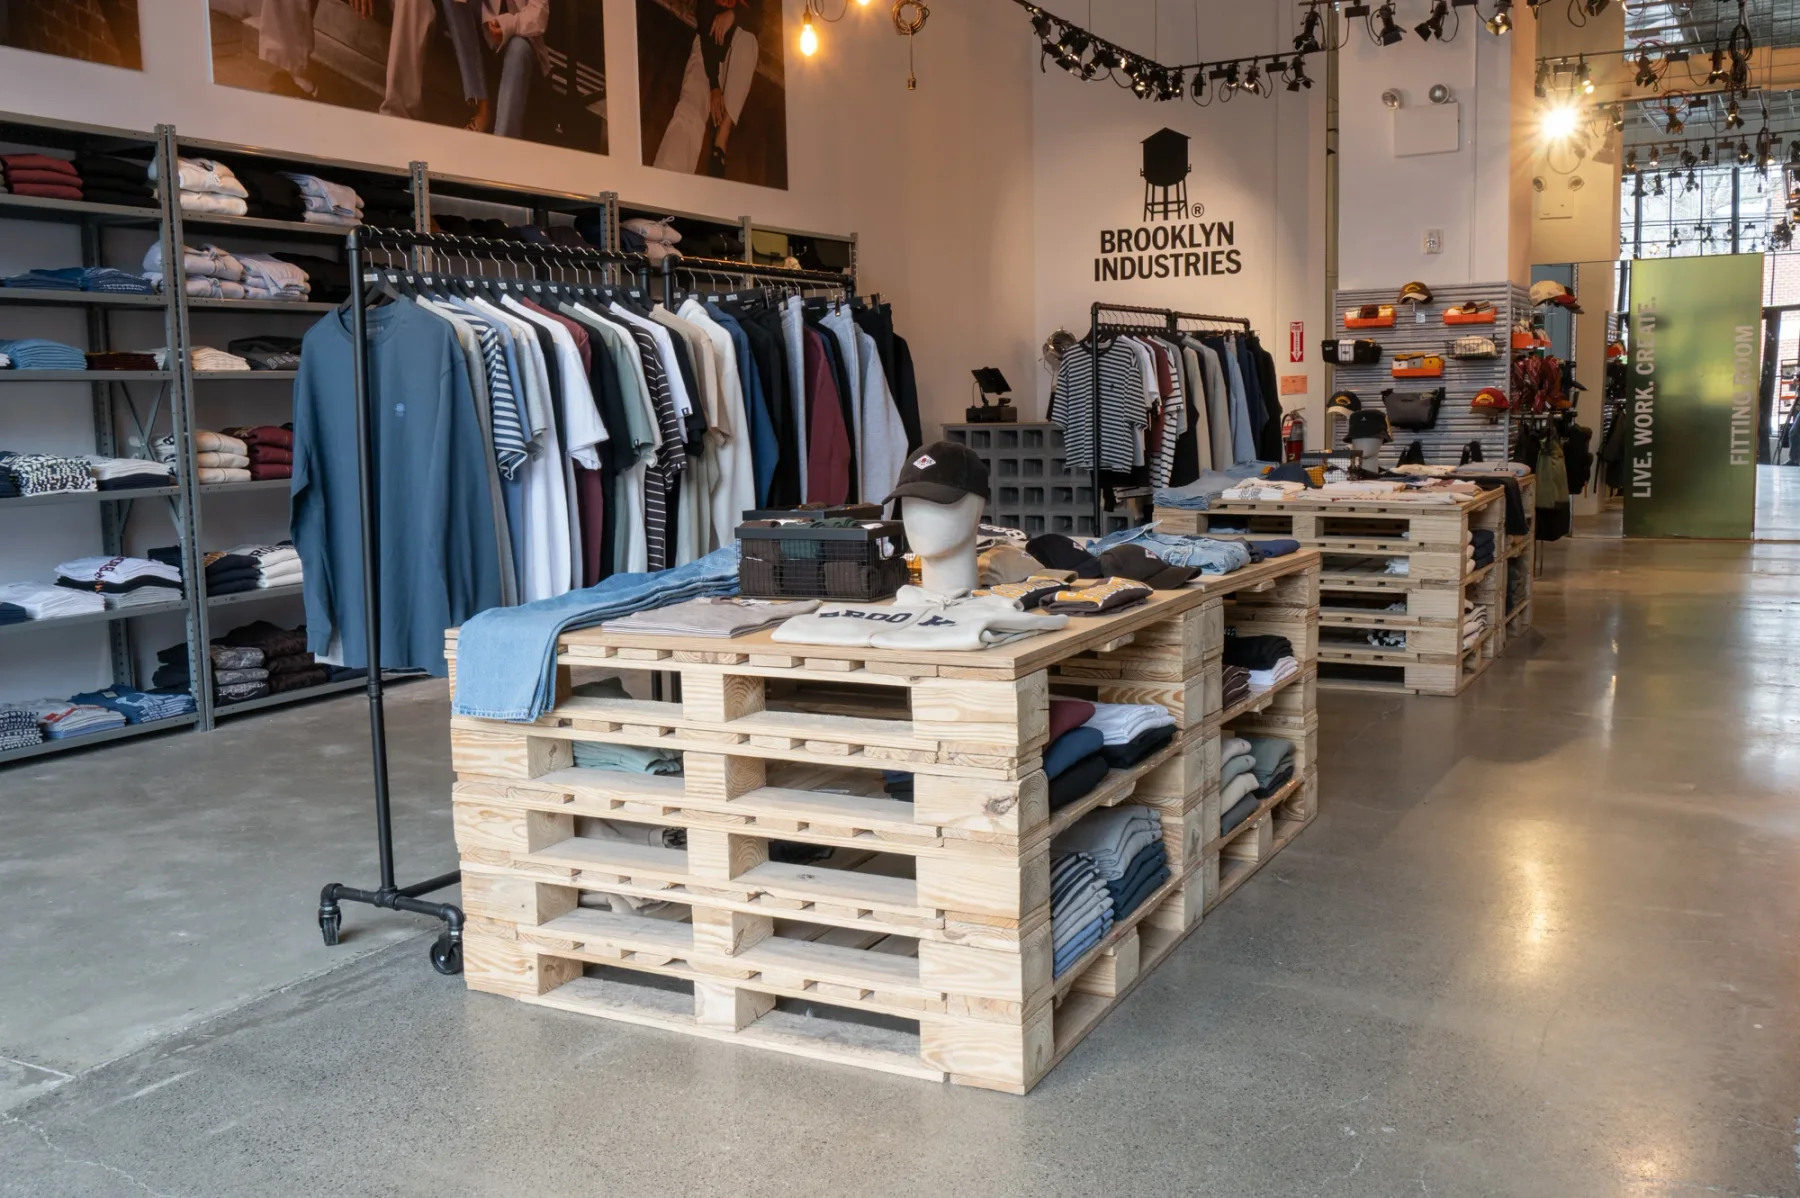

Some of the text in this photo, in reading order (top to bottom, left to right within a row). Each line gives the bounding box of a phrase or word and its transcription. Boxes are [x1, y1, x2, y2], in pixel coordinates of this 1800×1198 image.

[1095, 249, 1241, 281] INDUSTRIES
[1101, 221, 1233, 254] BROOKLYN
[1633, 297, 1656, 497] LIVE. WORK. CREATE.
[1730, 325, 1754, 465] FITTING ROOM
